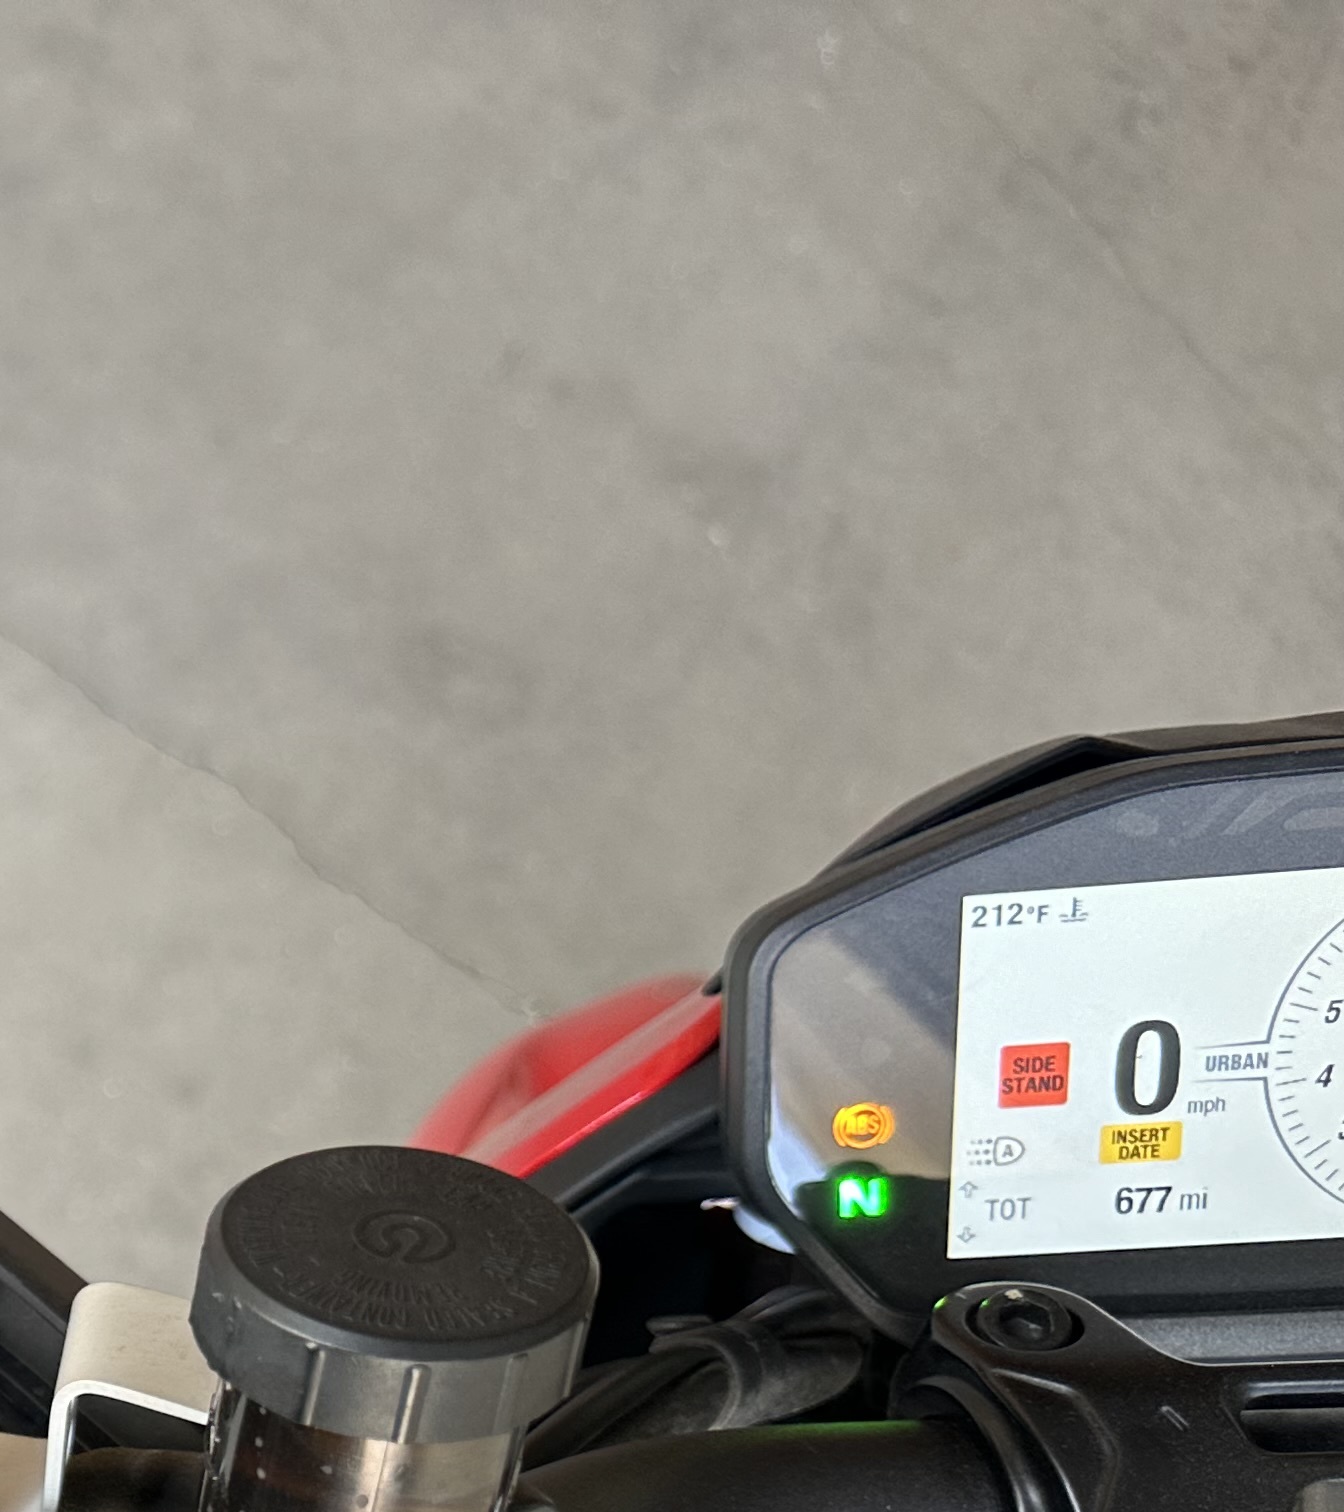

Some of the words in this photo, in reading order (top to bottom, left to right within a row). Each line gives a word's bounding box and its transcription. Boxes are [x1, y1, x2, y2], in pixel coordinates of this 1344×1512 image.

[971, 903, 1050, 928] 212°F
[1324, 999, 1344, 1024] 5
[1013, 1055, 1056, 1075] SIDE
[1114, 1019, 1181, 1116] 0
[1205, 1052, 1269, 1073] URBAN
[1001, 1074, 1065, 1096] STAND
[1315, 1064, 1335, 1088] 4
[1187, 1097, 1226, 1117] mph
[1112, 1126, 1170, 1145] INSERT
[1118, 1143, 1161, 1161] DATE
[838, 1178, 889, 1218] N
[984, 1196, 1032, 1222] TOT
[1114, 1185, 1173, 1215] 677
[1179, 1187, 1208, 1211] mi
